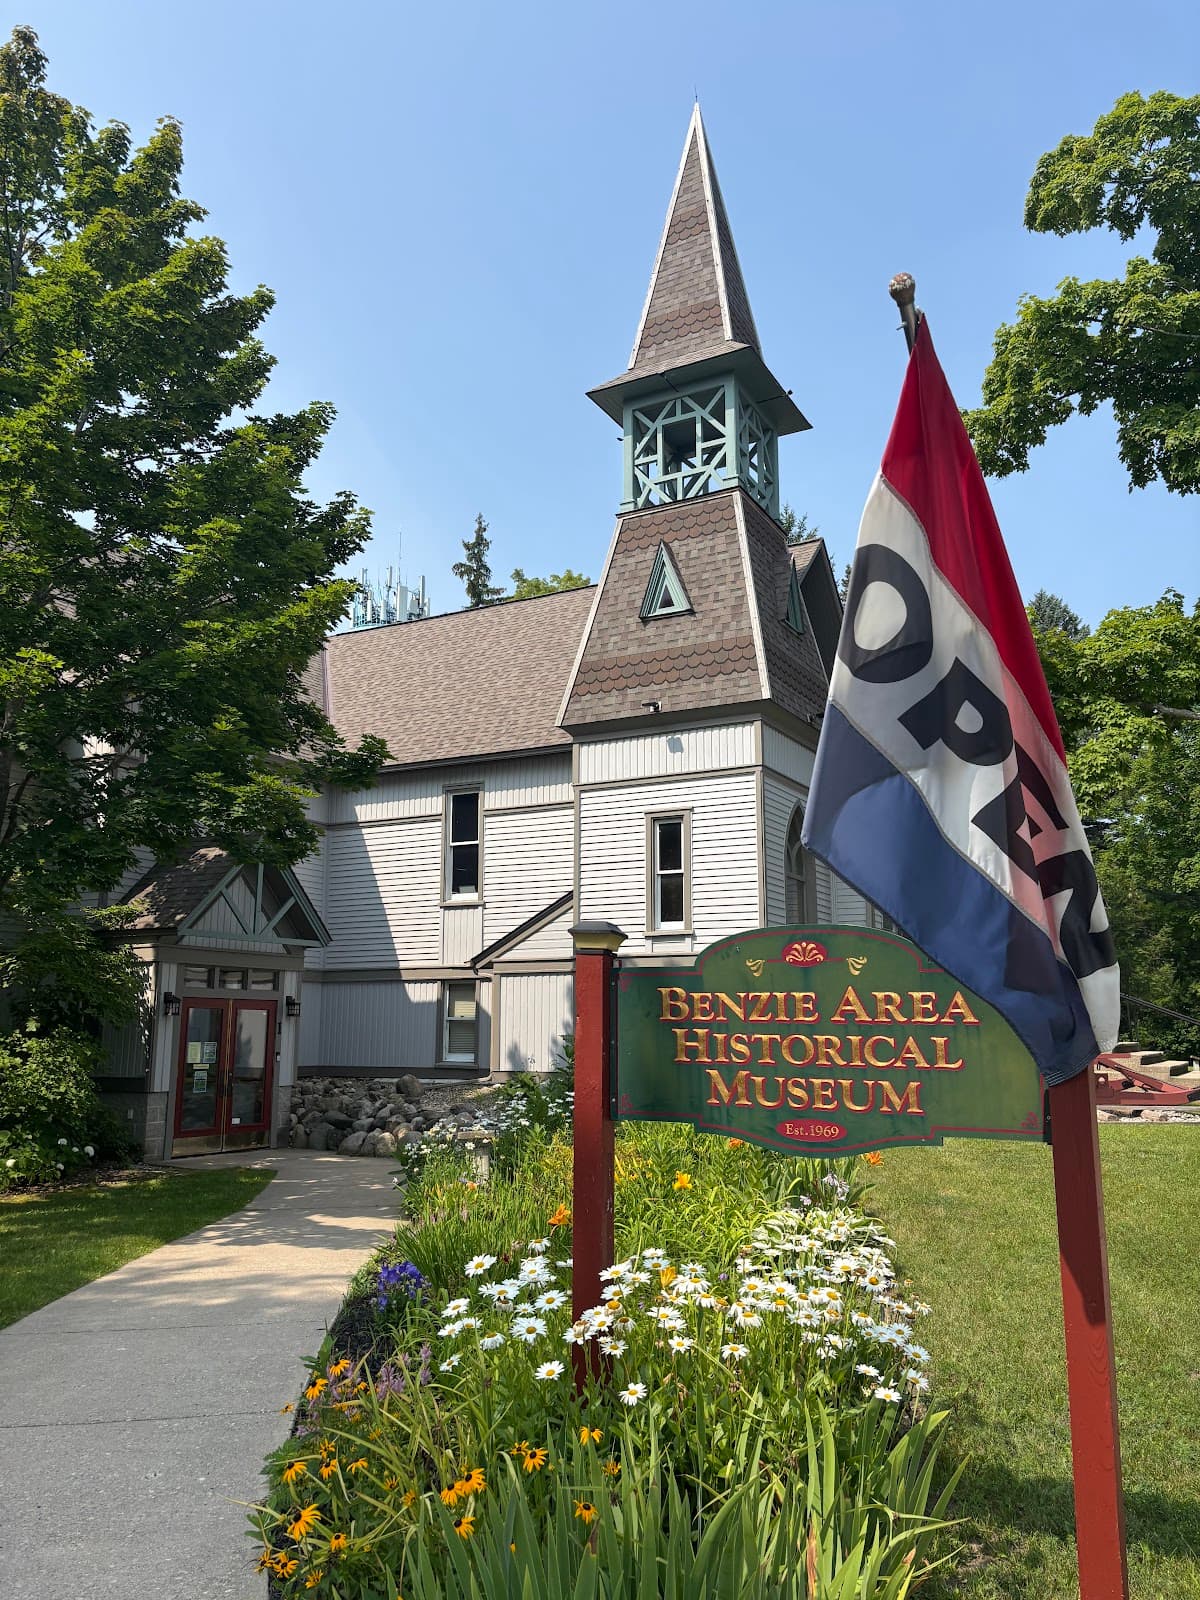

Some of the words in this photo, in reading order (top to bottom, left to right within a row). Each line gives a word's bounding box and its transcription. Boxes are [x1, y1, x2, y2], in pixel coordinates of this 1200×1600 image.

[657, 986, 820, 1022] BENZIE
[830, 985, 980, 1025] AREA
[672, 1028, 964, 1070] HISTORICAL
[705, 1069, 925, 1115] MUSEUM
